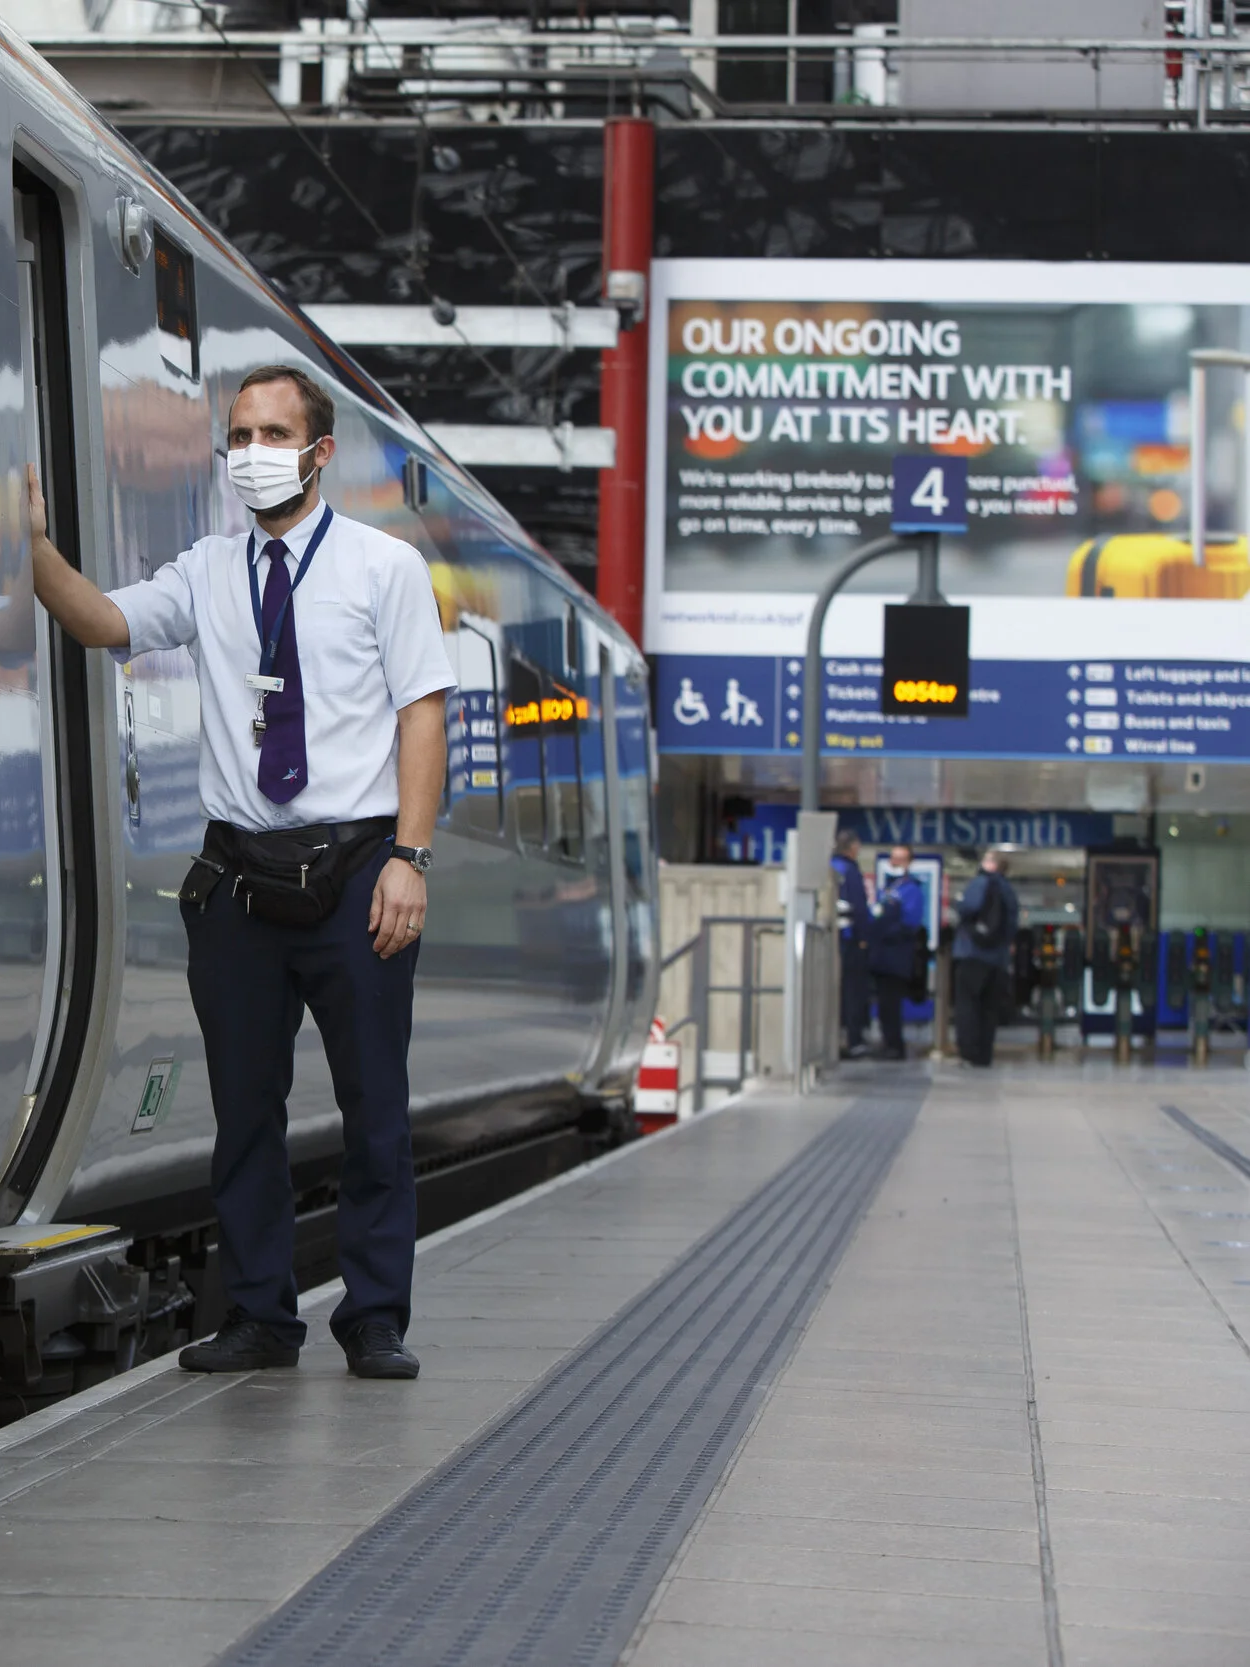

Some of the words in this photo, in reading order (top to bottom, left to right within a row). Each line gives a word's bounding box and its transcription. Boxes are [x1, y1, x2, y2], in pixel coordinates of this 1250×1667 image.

[682, 318, 766, 355] OUR
[774, 319, 961, 357] ONGOING
[681, 361, 955, 400] COMMITMENT
[962, 365, 1072, 400] WITH
[681, 405, 762, 442] YOU
[770, 407, 821, 443] AT
[828, 408, 890, 444] ITS
[899, 408, 1027, 445] HEART.
[679, 468, 726, 488] We're
[728, 469, 792, 492] working
[794, 470, 864, 493] tirelessly
[866, 472, 885, 490] to
[910, 466, 949, 516] 4
[679, 493, 722, 511] more
[724, 492, 783, 511] reliable
[785, 493, 841, 512] service
[843, 495, 863, 512] to
[864, 495, 893, 516] get
[980, 500, 1012, 518] you
[1014, 499, 1055, 515] need
[1058, 499, 1077, 515] to
[678, 517, 701, 536] go
[703, 518, 726, 533] on
[771, 518, 816, 537] every
